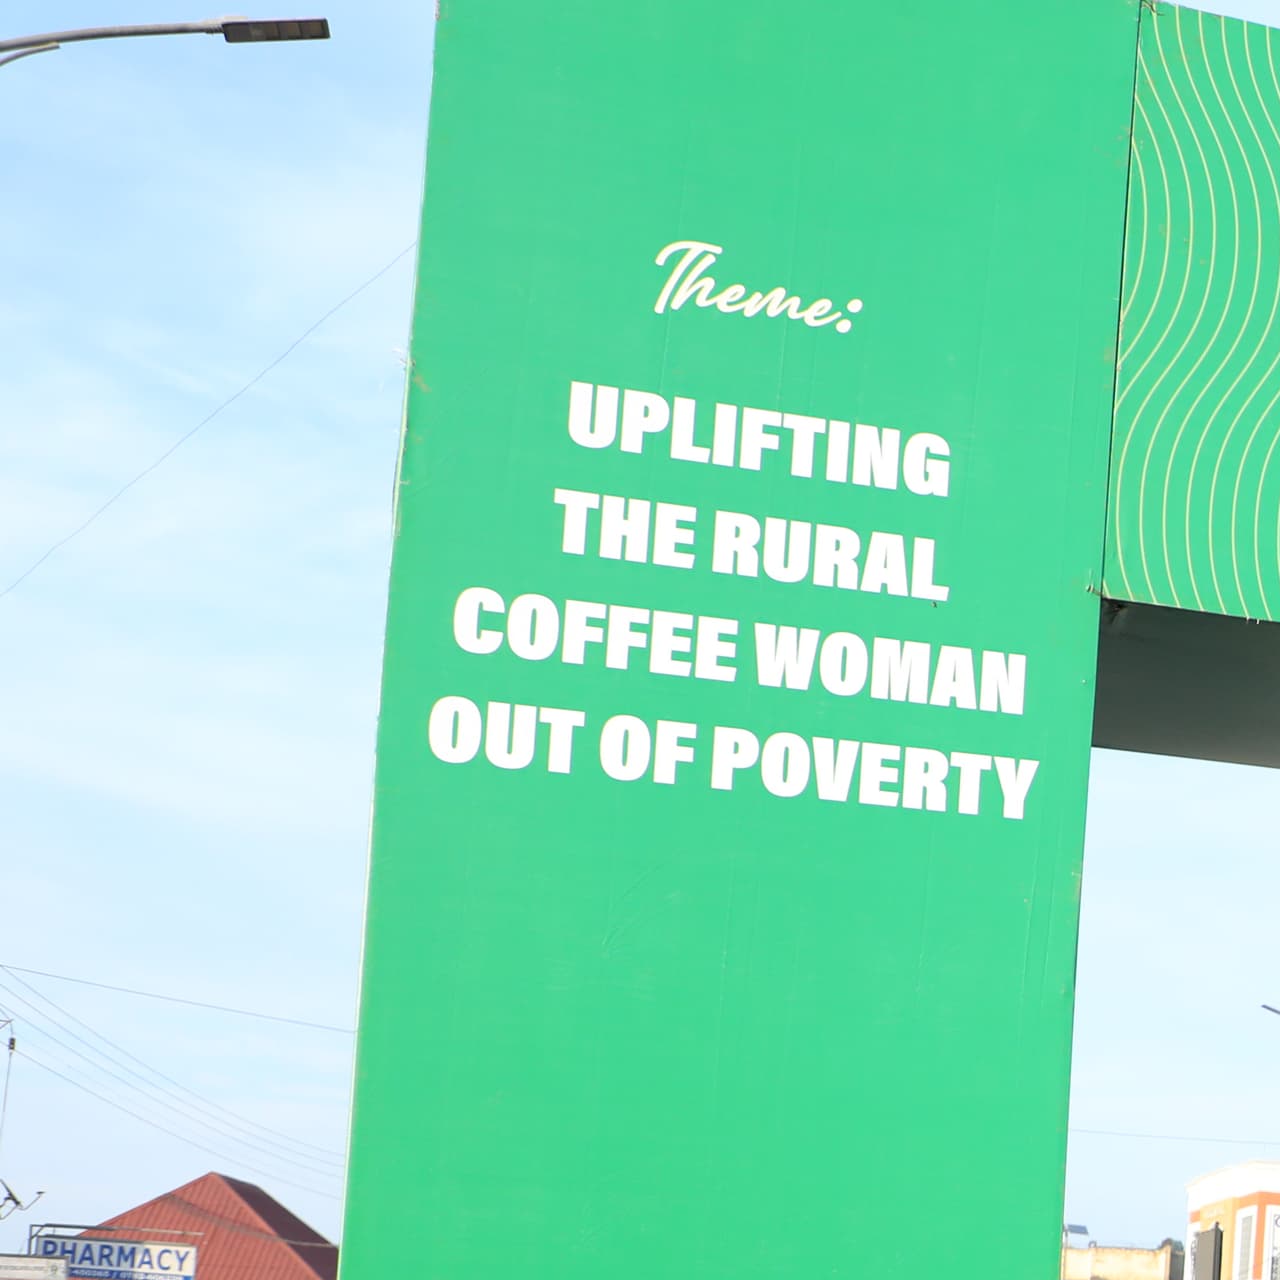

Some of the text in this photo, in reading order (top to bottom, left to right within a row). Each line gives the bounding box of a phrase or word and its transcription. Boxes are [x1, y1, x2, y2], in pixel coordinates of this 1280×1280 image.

[655, 241, 863, 333] Theme:
[568, 380, 951, 497] UPLIFTING
[553, 487, 950, 602] THE RURAL
[453, 587, 1027, 715] COFFEE WOMAN
[428, 695, 1040, 820] OUT OF POVERTY
[42, 1239, 191, 1272] PHARMACY
